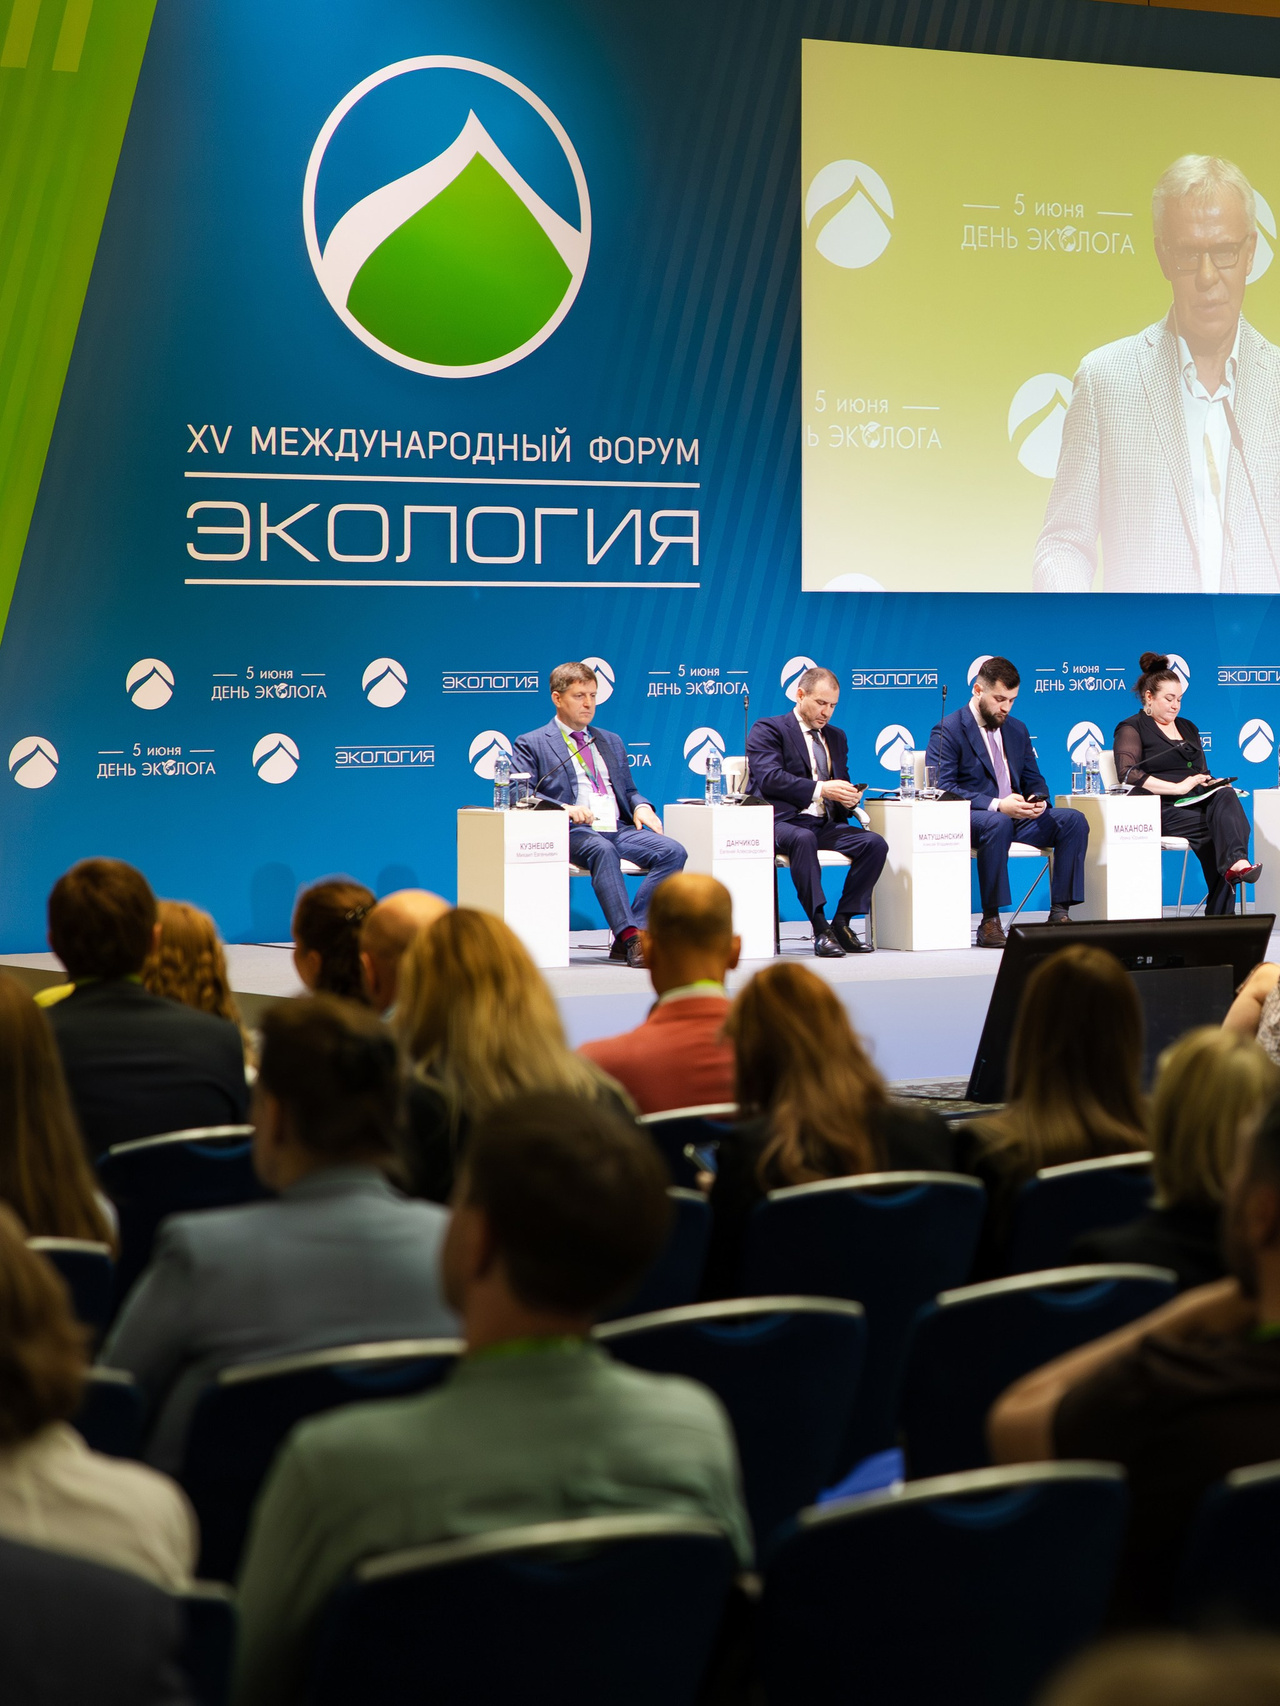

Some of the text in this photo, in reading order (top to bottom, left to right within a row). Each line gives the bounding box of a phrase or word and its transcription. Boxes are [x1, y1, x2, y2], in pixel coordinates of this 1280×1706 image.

[1013, 195, 1085, 218] 5 июня
[960, 225, 1135, 255] ДЕНЬ ЭКОЛОГА
[814, 390, 888, 414] 5 июня
[829, 420, 942, 450] ЭКОЛОГА
[186, 424, 699, 466] XV МЕЖДУНАРОДНЫЙ ФОРУМ
[186, 500, 699, 566] ЭКОЛОГИЯ
[246, 666, 294, 680] 5 июня
[678, 664, 720, 677] 5 июня
[1062, 662, 1100, 674] 5 июня
[442, 676, 539, 690] ЭКОЛОГИЯ
[852, 672, 938, 688] ЭКОЛОГИЯ
[1034, 676, 1126, 694] ДЕНЬ ЭКОЛОГА
[211, 683, 327, 701] ДЕНЬ ЭКОЛОГА
[647, 680, 750, 698] ДЕНЬ ЭКОЛОГА
[132, 743, 182, 757] 5 июня
[334, 750, 435, 764] ЭКОЛОГИЯ
[96, 760, 216, 779] ДЕНЬ ЭКОЛОГА
[918, 832, 964, 840] МАТУШАНСКИЙ
[1114, 824, 1154, 833] МАКАНОВА
[520, 842, 554, 850] КУЗНЕЦОВ
